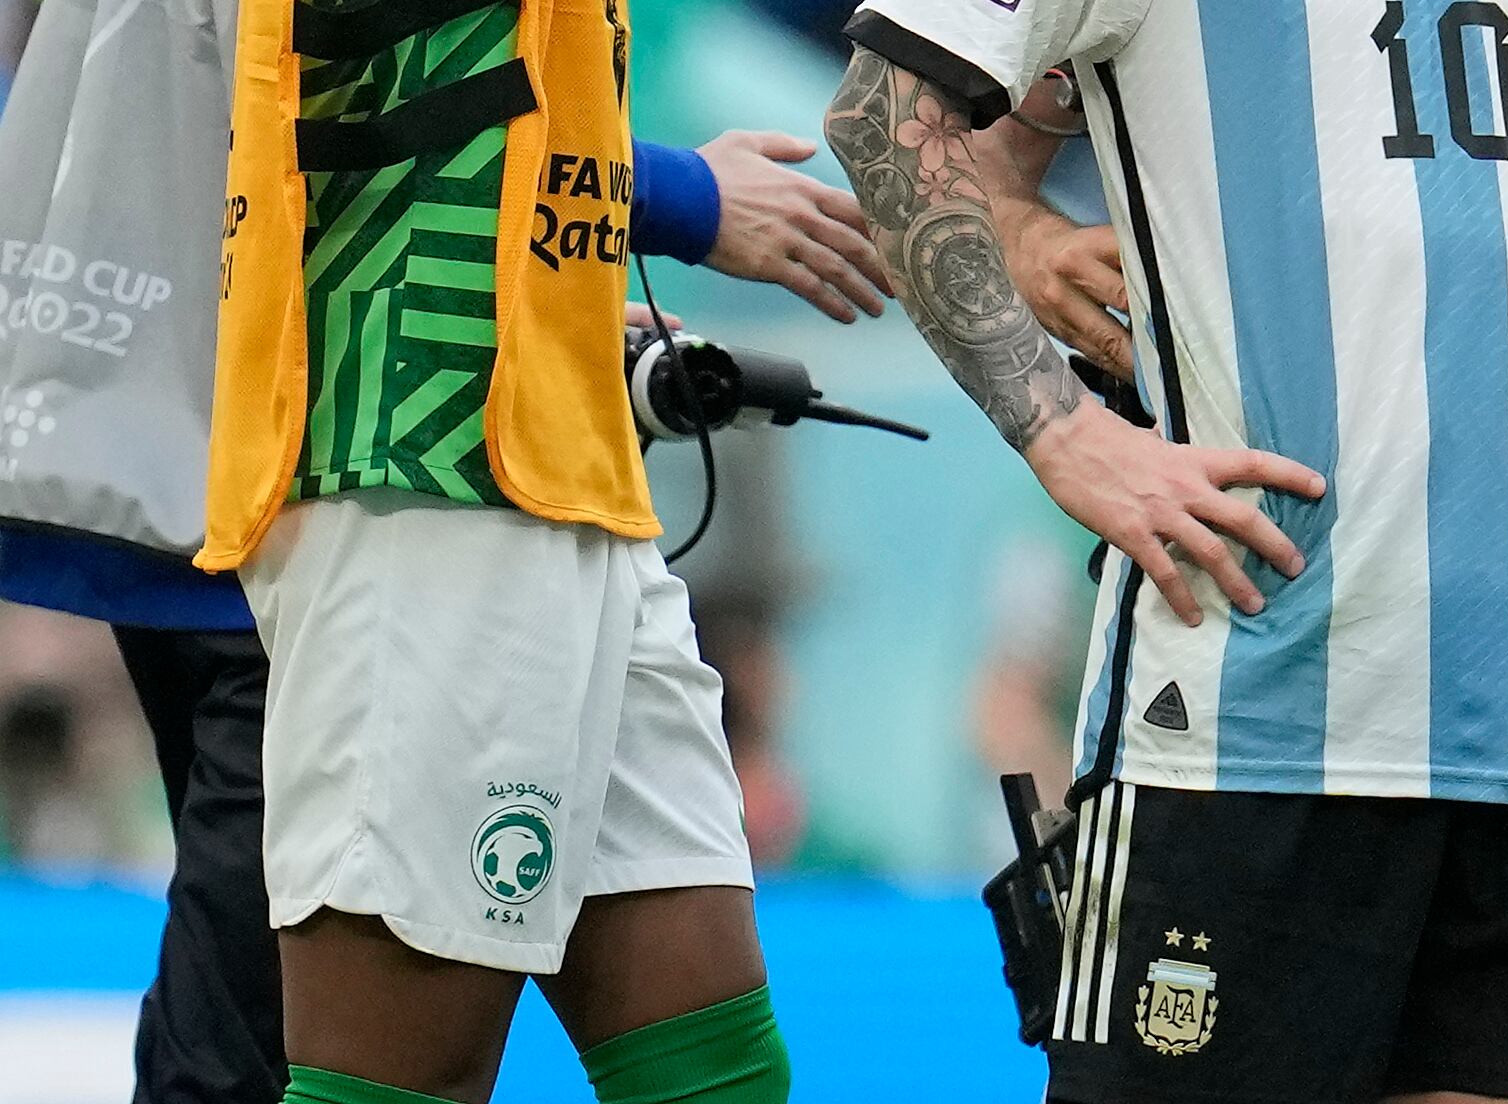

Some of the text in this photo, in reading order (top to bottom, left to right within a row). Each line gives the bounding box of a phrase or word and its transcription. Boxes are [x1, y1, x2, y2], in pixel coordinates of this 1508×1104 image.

[83, 260, 174, 311] CUP
[487, 781, 562, 809] السعودية
[518, 866, 541, 877] SAFF
[1154, 984, 1196, 1029] AFA
